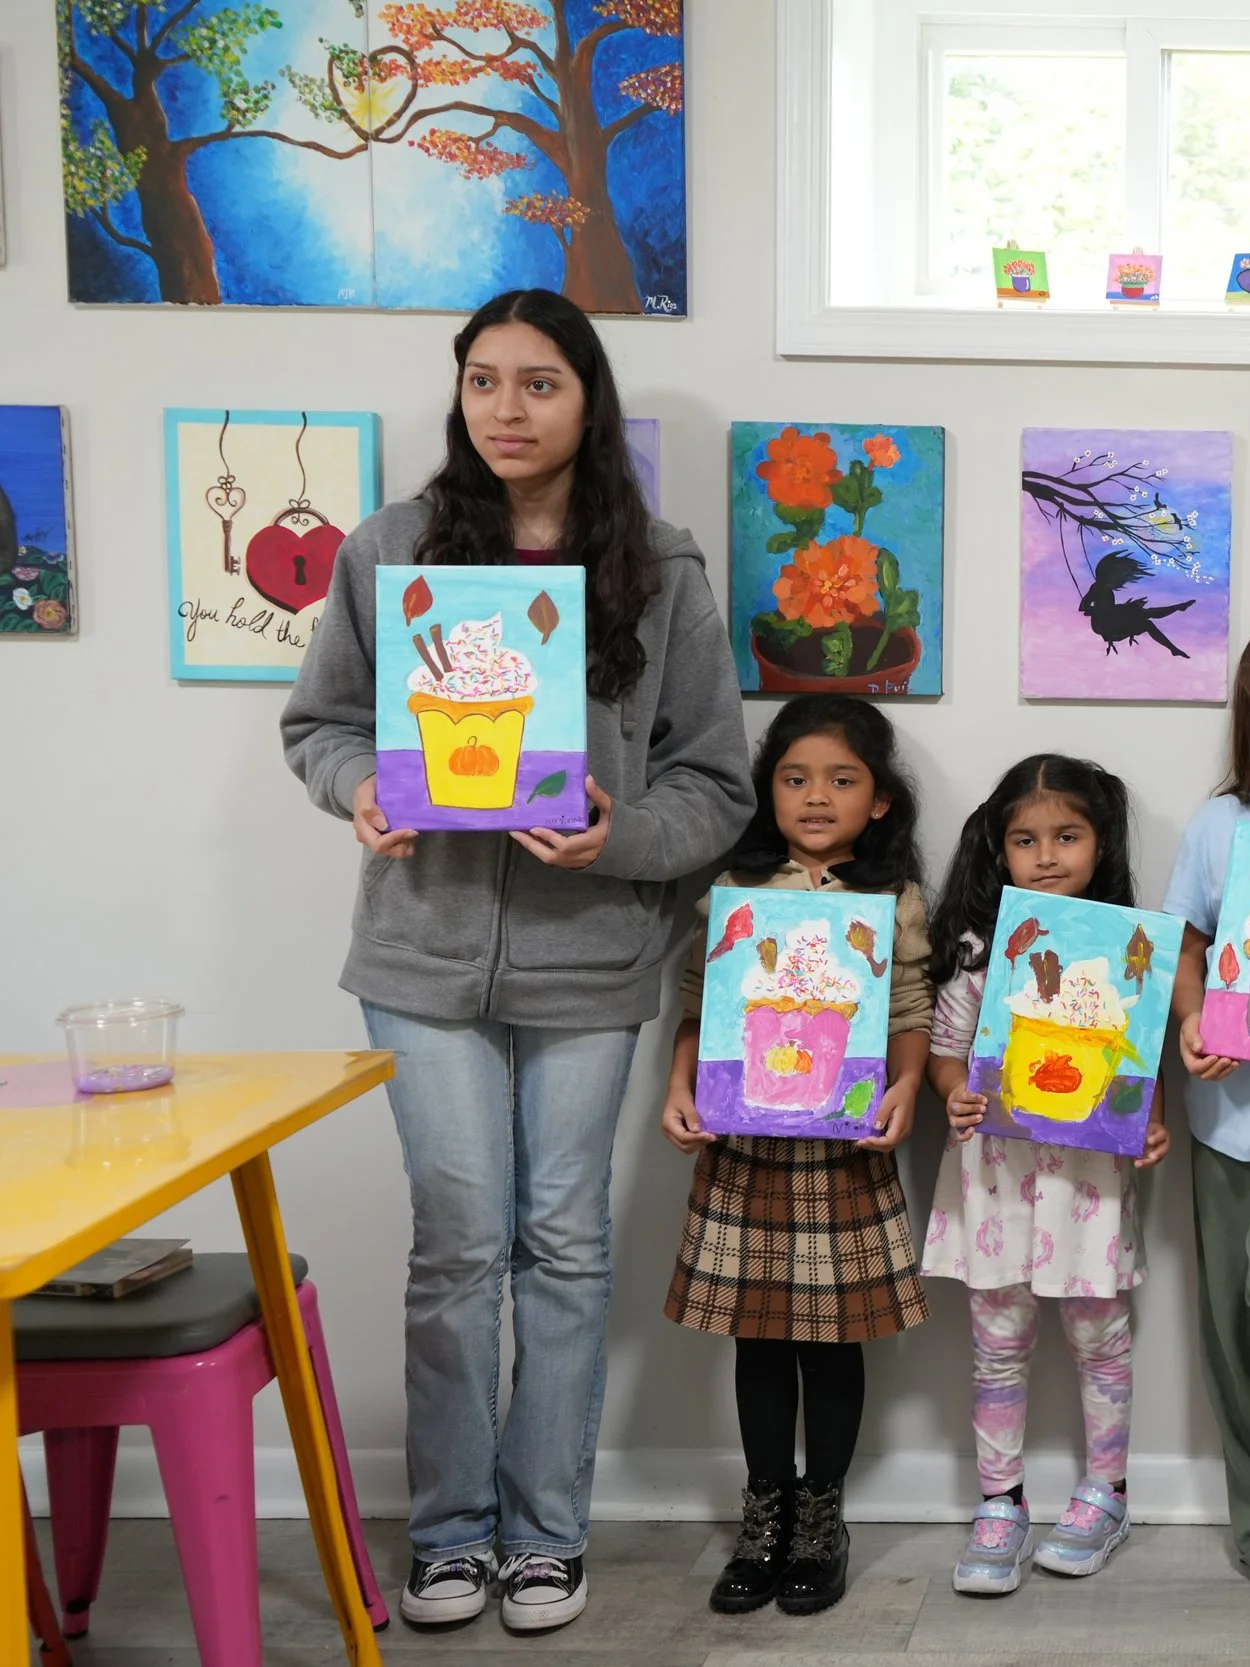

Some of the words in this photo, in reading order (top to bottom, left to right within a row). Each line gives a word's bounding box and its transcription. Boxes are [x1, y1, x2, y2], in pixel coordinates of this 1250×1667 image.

[178, 597, 219, 642] You
[225, 597, 274, 640] hold
[276, 618, 306, 648] the
